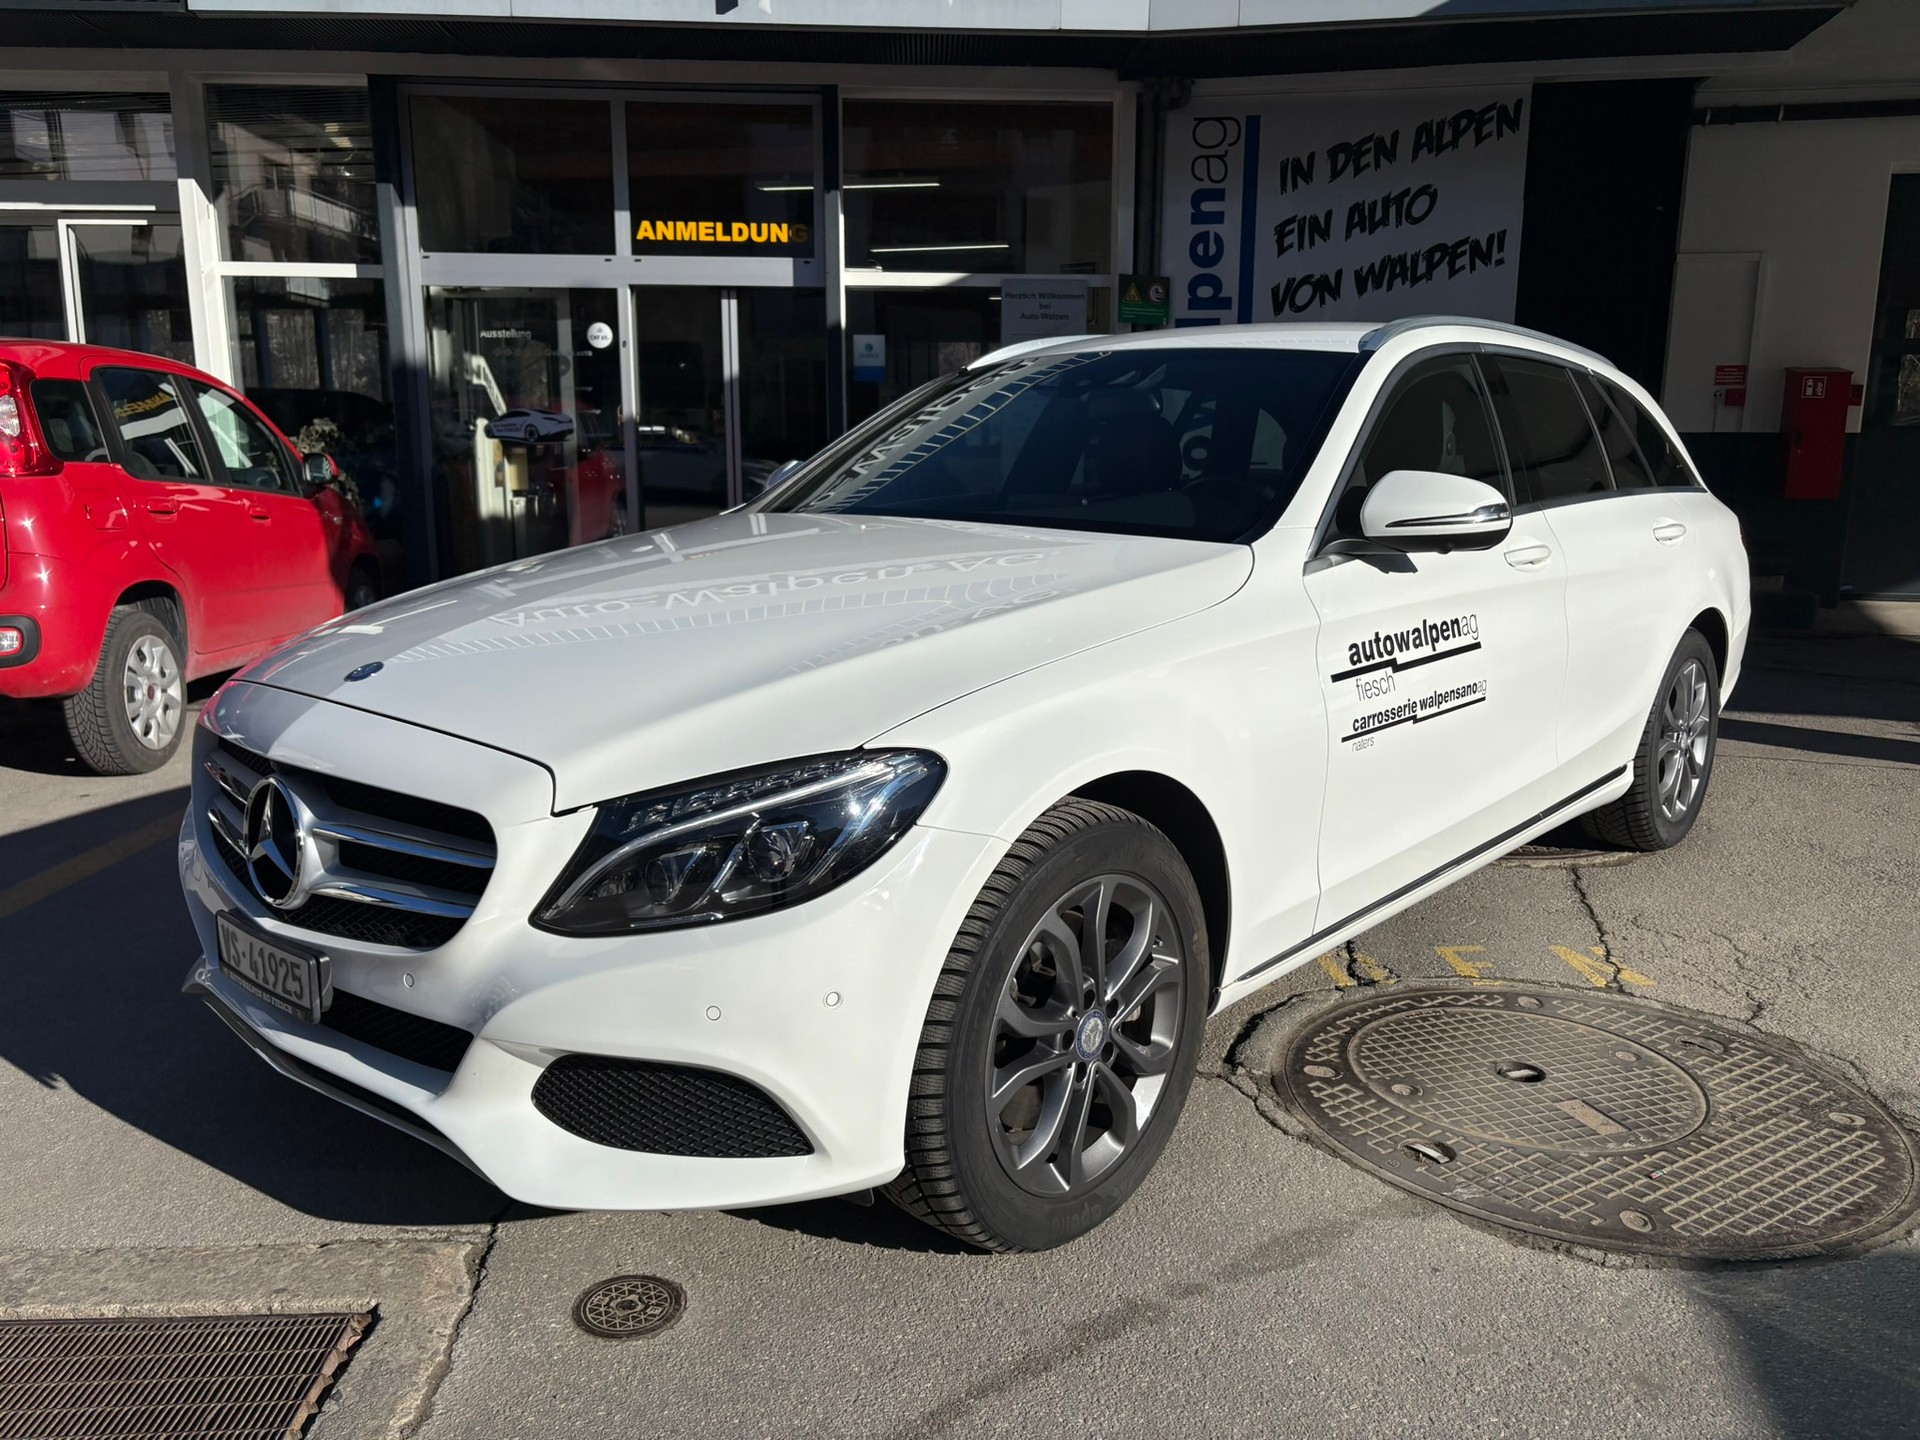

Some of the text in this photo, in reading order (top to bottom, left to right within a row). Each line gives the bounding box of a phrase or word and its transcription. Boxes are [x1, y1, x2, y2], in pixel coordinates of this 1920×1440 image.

[1279, 97, 1524, 194] IN DEN ALPEN
[636, 219, 808, 244] ANMELDUNG
[1273, 184, 1438, 258] EIN AUTO
[1270, 229, 1507, 317] VON WALPEN!
[1005, 292, 1085, 301] Herzlich Willkommen
[1039, 302, 1051, 310] bei
[1020, 312, 1070, 322] Auto-Walpen
[480, 328, 532, 340] Ausstellung
[1355, 672, 1396, 701] fiesch
[1352, 699, 1417, 732] carrosserie
[1351, 736, 1375, 753] naters
